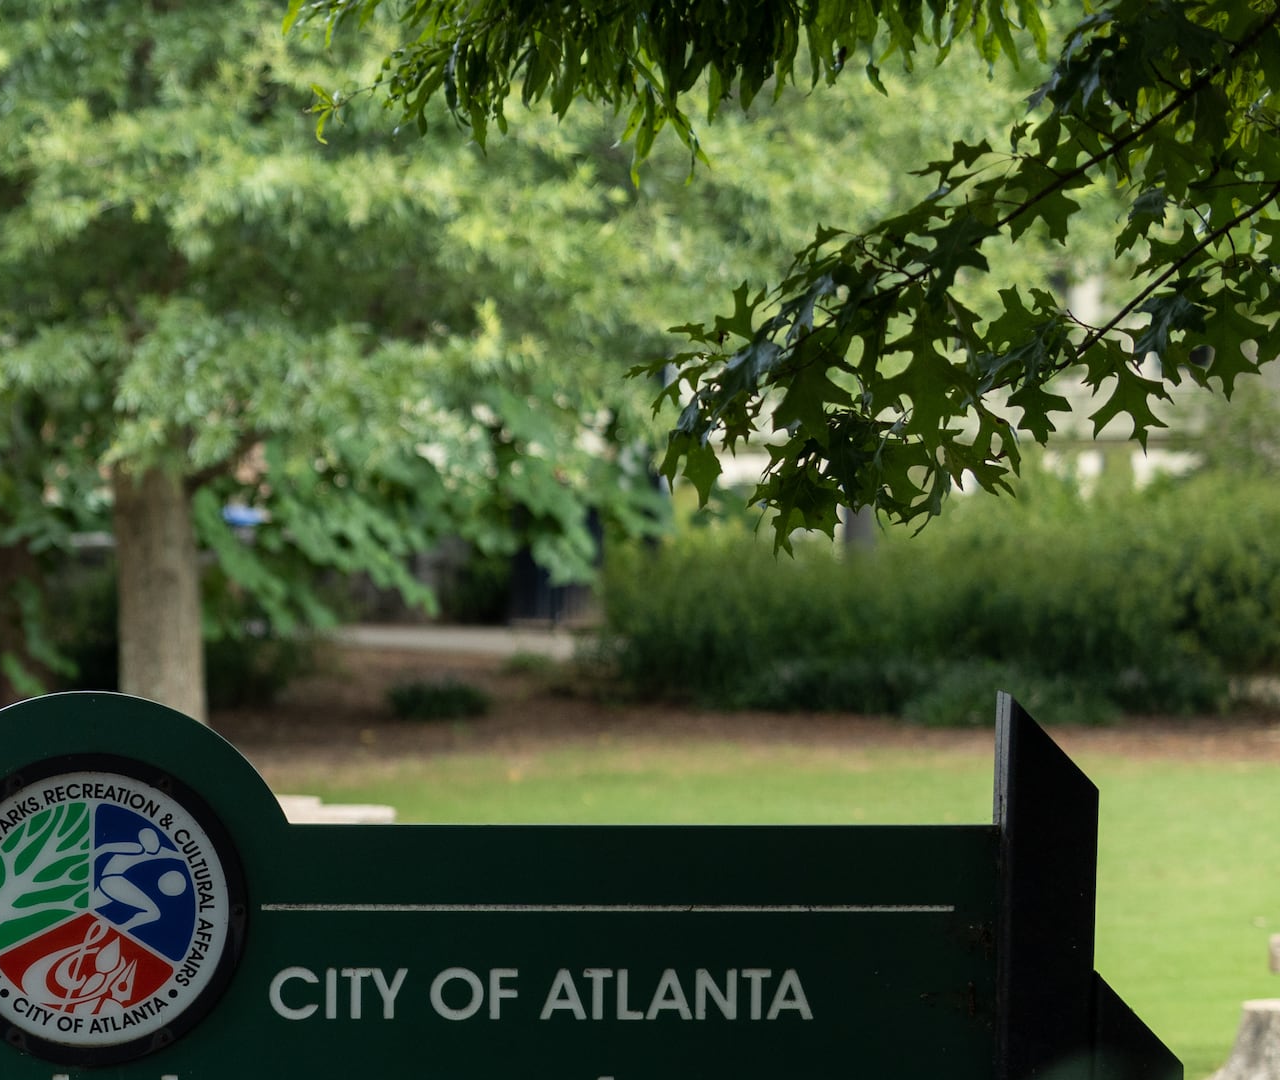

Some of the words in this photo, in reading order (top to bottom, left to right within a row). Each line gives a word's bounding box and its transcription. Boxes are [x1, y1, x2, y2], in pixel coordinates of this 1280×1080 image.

[44, 783, 161, 818] RECREATION
[159, 813, 174, 830] &
[174, 829, 215, 913] CULTURAL
[175, 917, 214, 987] AFFAIRS
[12, 997, 54, 1026] CITY
[57, 1015, 83, 1033] OF
[89, 995, 168, 1034] ATLANTA
[269, 967, 408, 1020] CITY
[430, 968, 518, 1021] OF
[540, 969, 813, 1020] ATLANTA
